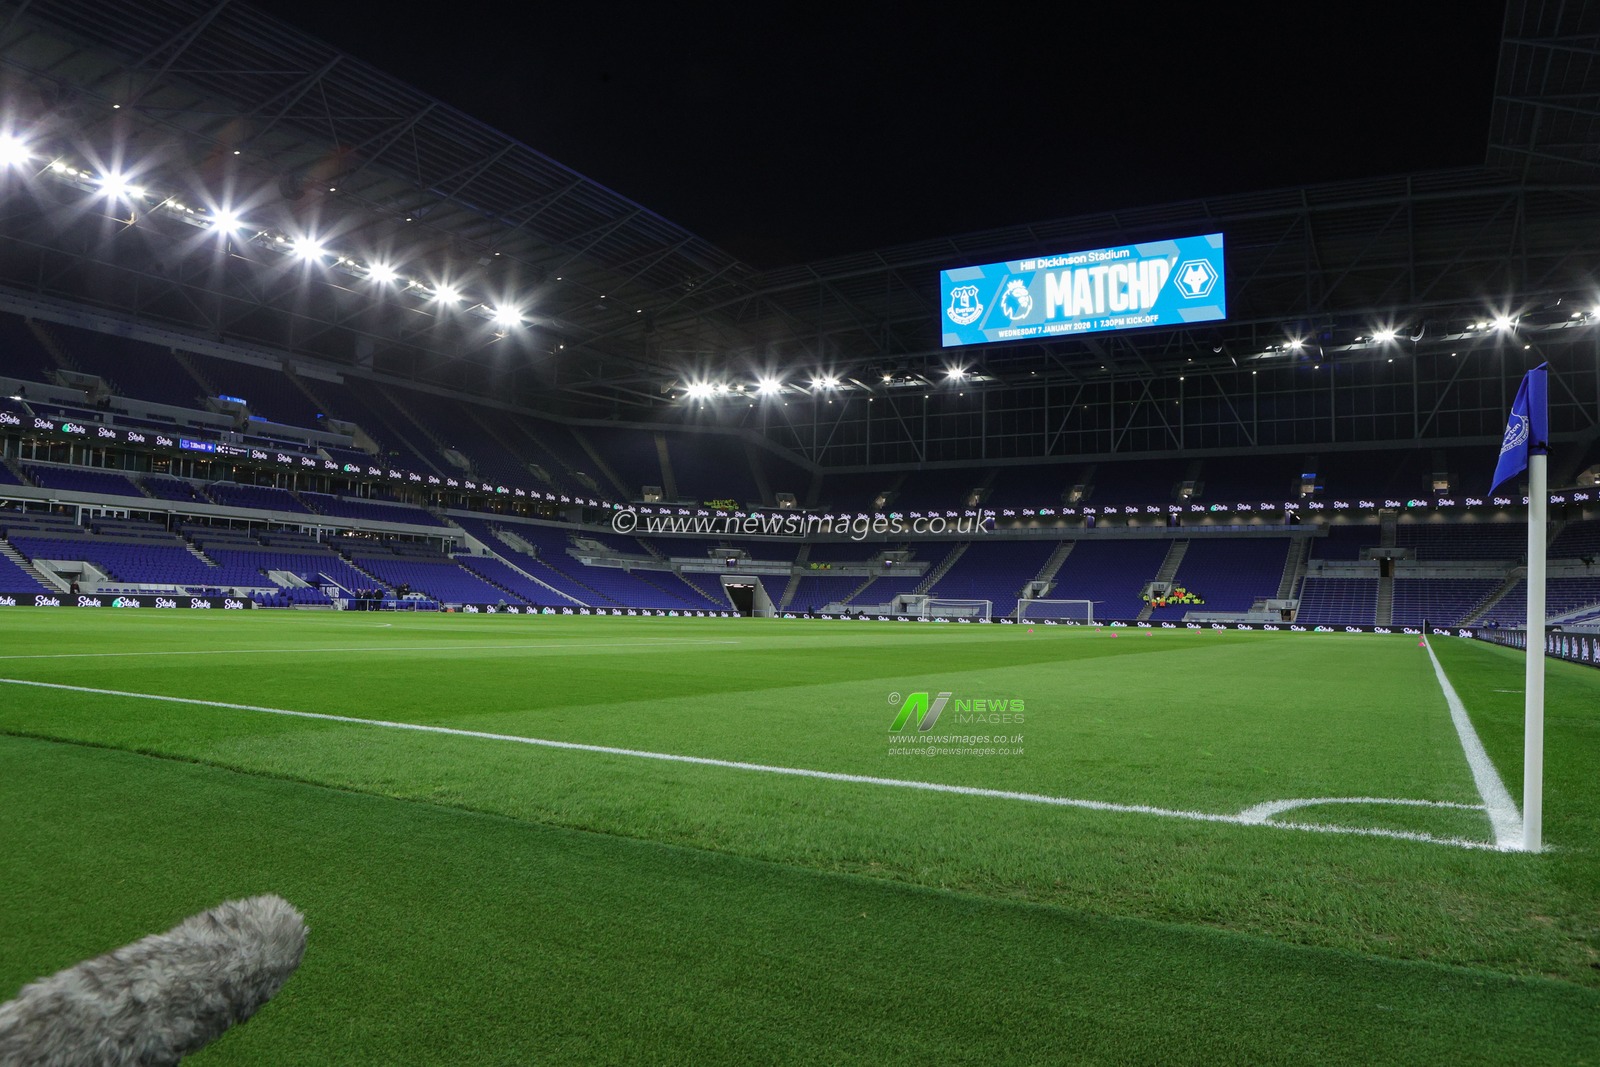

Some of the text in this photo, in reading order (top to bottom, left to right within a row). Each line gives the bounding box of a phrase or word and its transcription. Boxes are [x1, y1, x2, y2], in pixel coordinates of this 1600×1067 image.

[1020, 249, 1130, 271] Hill Dickinson Stadium
[1044, 257, 1178, 319] MATCHD
[998, 327, 1037, 338] WEDNESDAY
[1038, 326, 1043, 334] 7
[1043, 323, 1072, 333] JANUARY
[1100, 318, 1125, 328] 7.30PM
[1126, 314, 1159, 325] KICK-OFF
[0, 595, 243, 609] take Stake Stake Stake Stake Stake Stake
